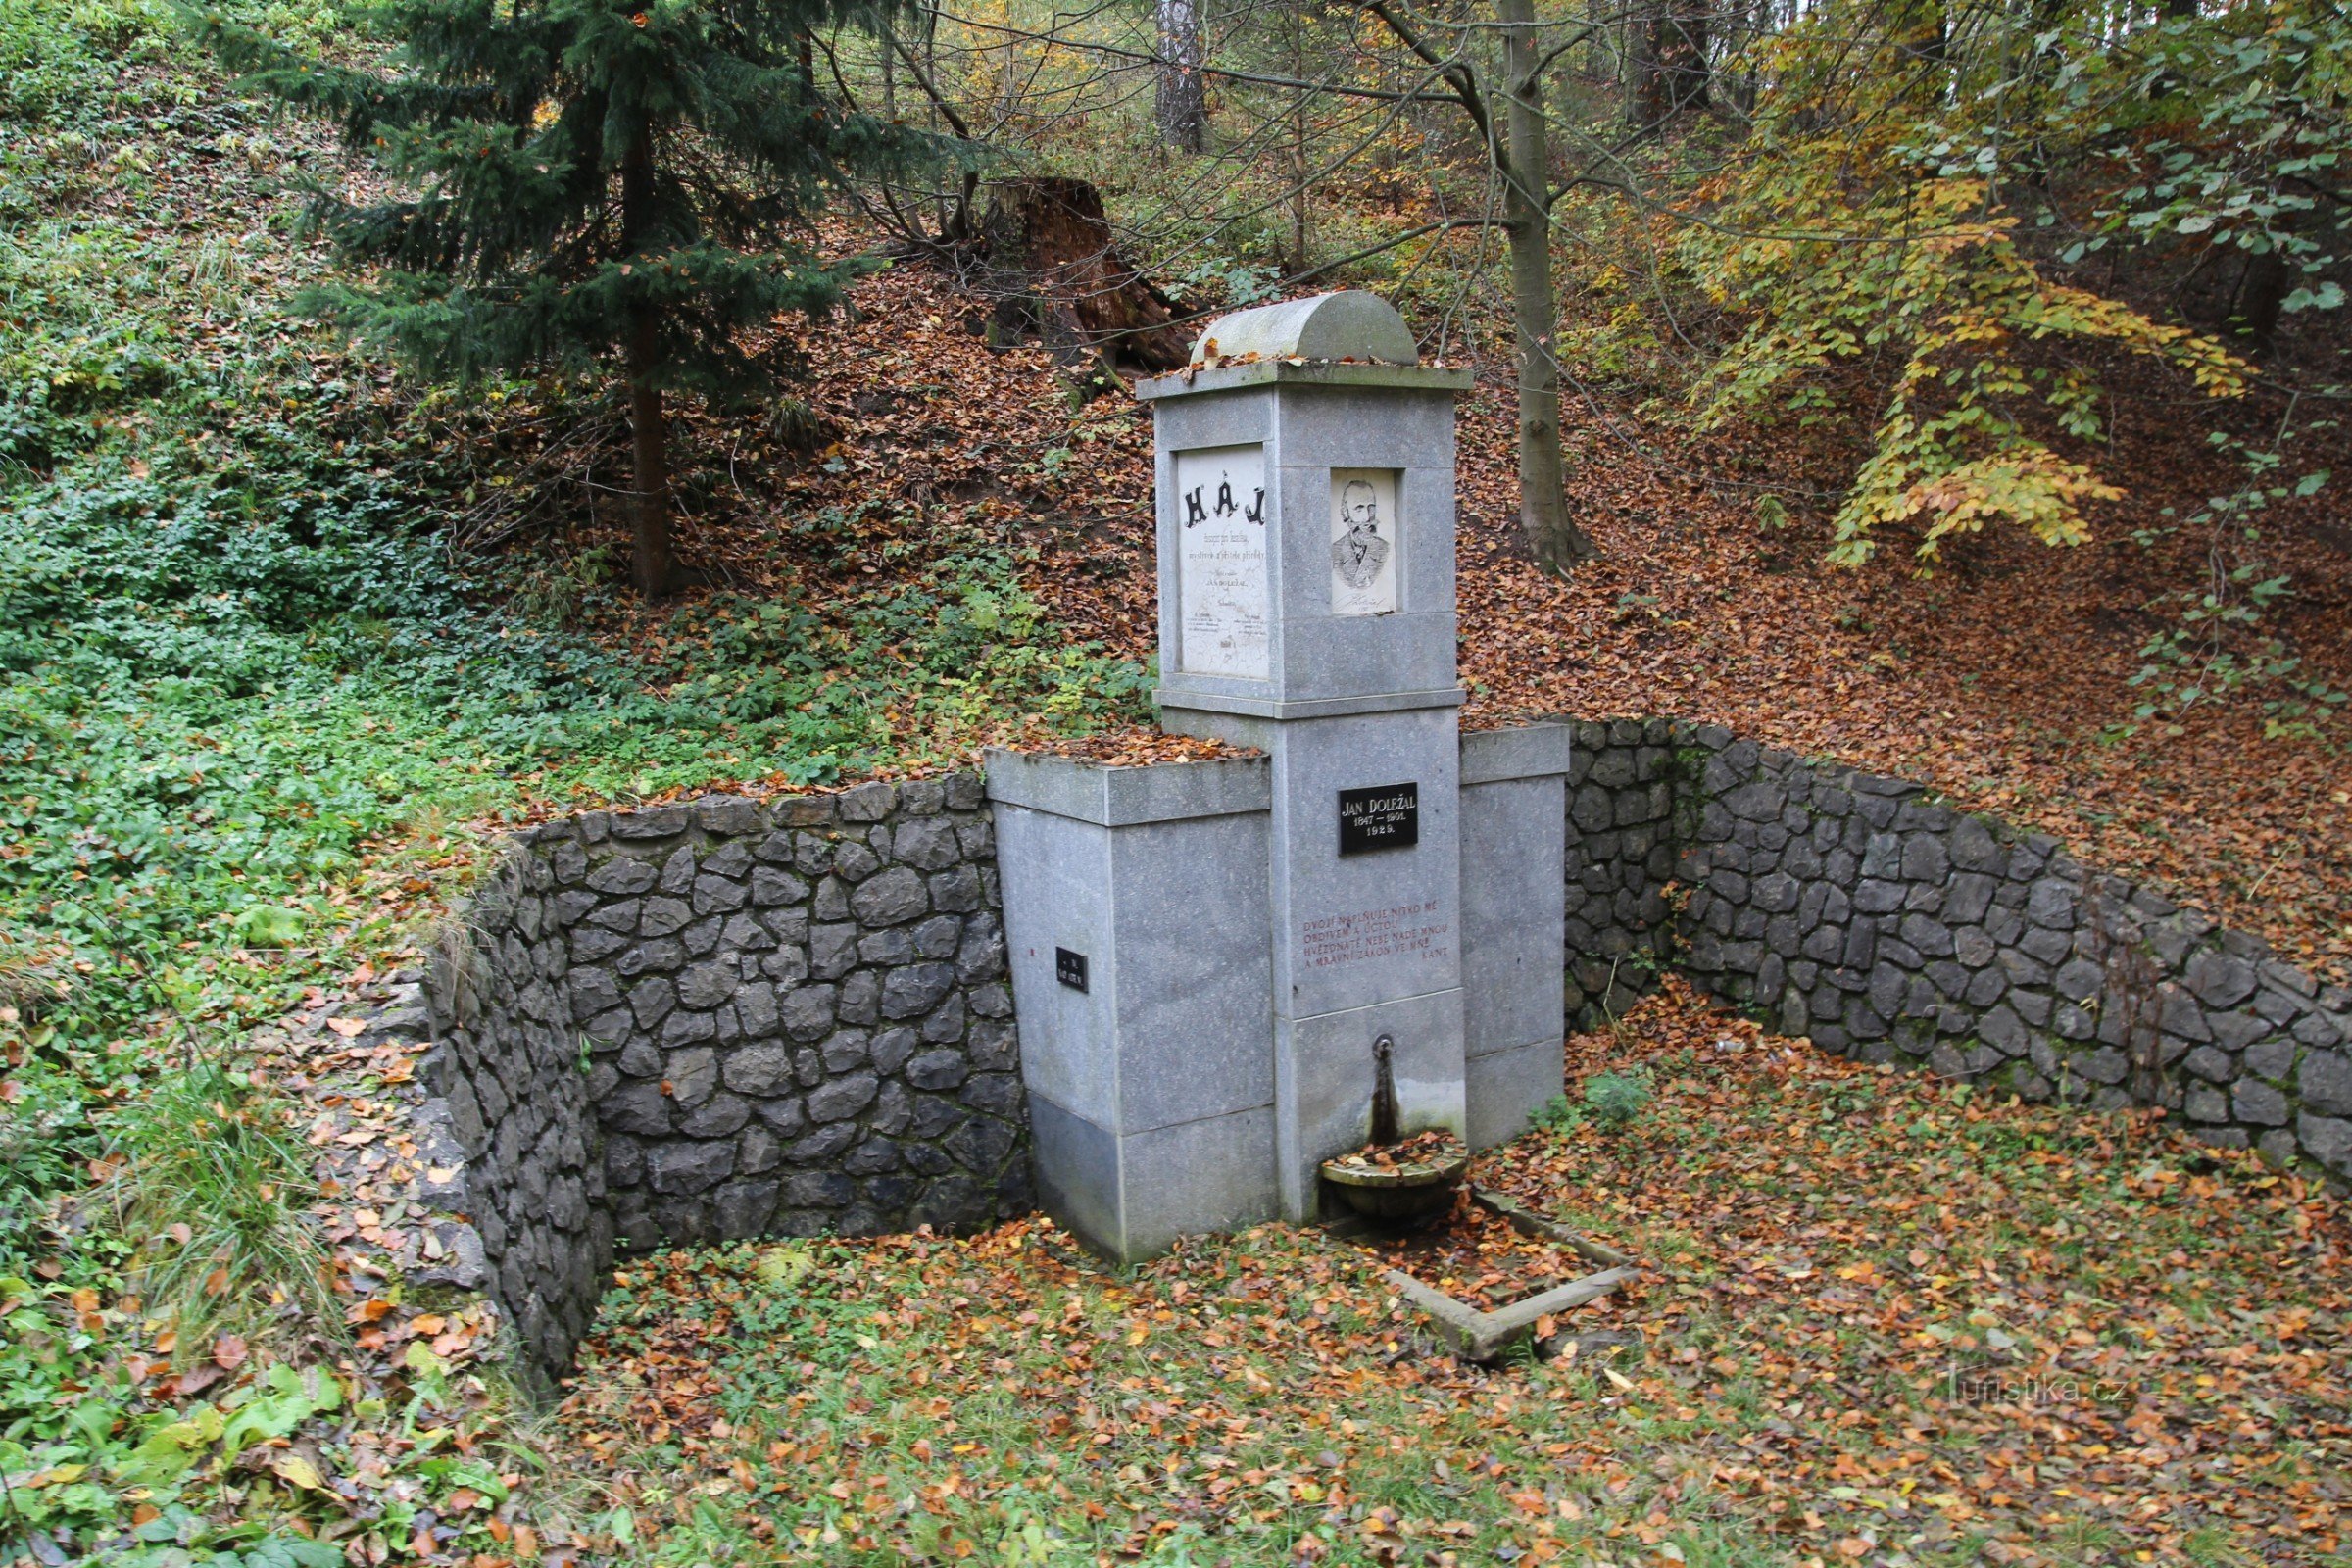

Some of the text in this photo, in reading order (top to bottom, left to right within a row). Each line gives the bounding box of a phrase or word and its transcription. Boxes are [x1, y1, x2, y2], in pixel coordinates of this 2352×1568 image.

[1342, 793, 1416, 817] JAN DOLEŽAL
[1353, 815, 1374, 827] 1847
[1391, 904, 1421, 917] NITRO
[1365, 934, 1389, 947] NEBE
[1392, 928, 1418, 941] NADE
[1421, 923, 1448, 936] MNOU
[1395, 943, 1406, 954] VE
[1422, 947, 1448, 960] KANT
